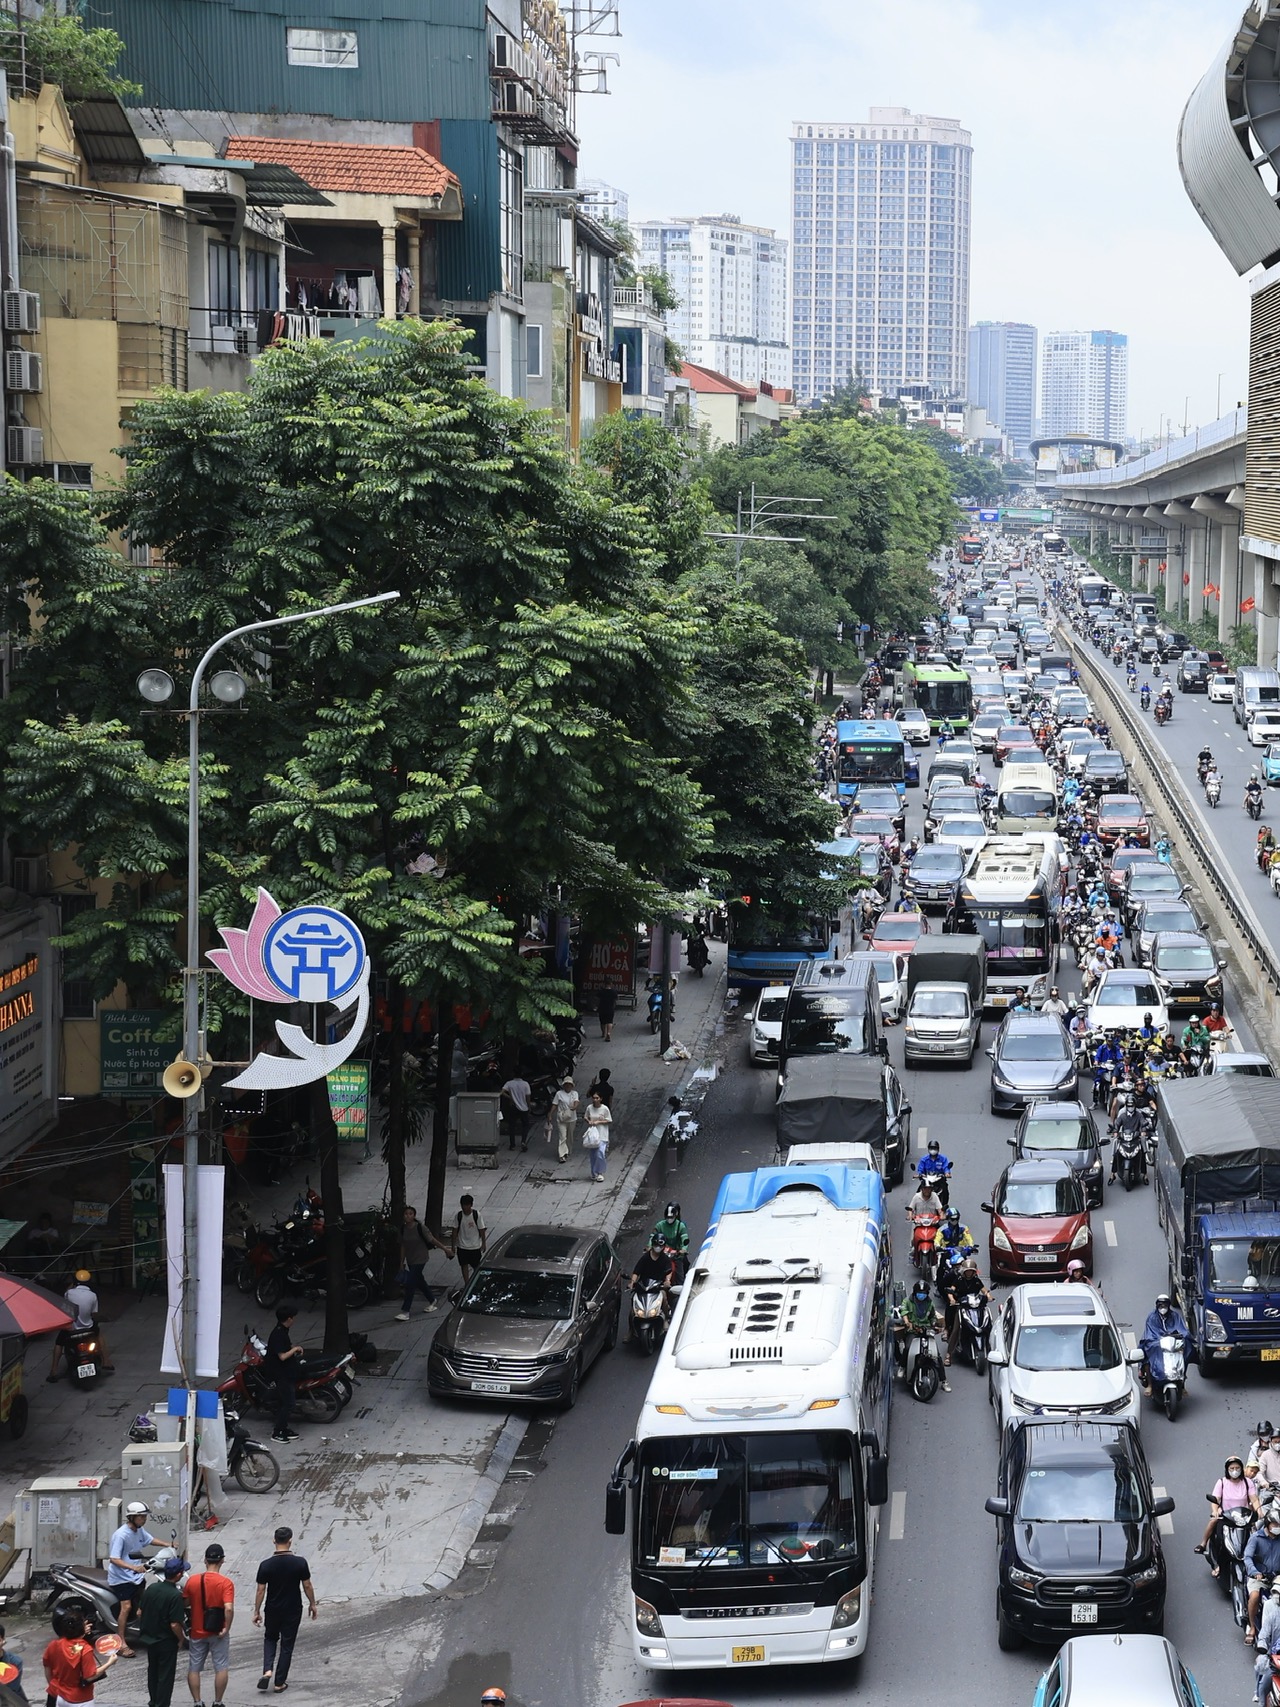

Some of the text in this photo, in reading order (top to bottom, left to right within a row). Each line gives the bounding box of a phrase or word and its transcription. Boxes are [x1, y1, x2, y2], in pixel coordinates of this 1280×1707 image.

[978, 910, 1000, 919] VIP
[126, 1048, 146, 1057] Sinh
[142, 1060, 160, 1068] Hoa
[1237, 1307, 1254, 1320] NAM
[706, 1606, 789, 1618] UNIVERSE
[1078, 1604, 1092, 1612] 29H
[1073, 1614, 1097, 1622] 153.18
[741, 1647, 755, 1655] 29B
[736, 1653, 761, 1662] 177.70
